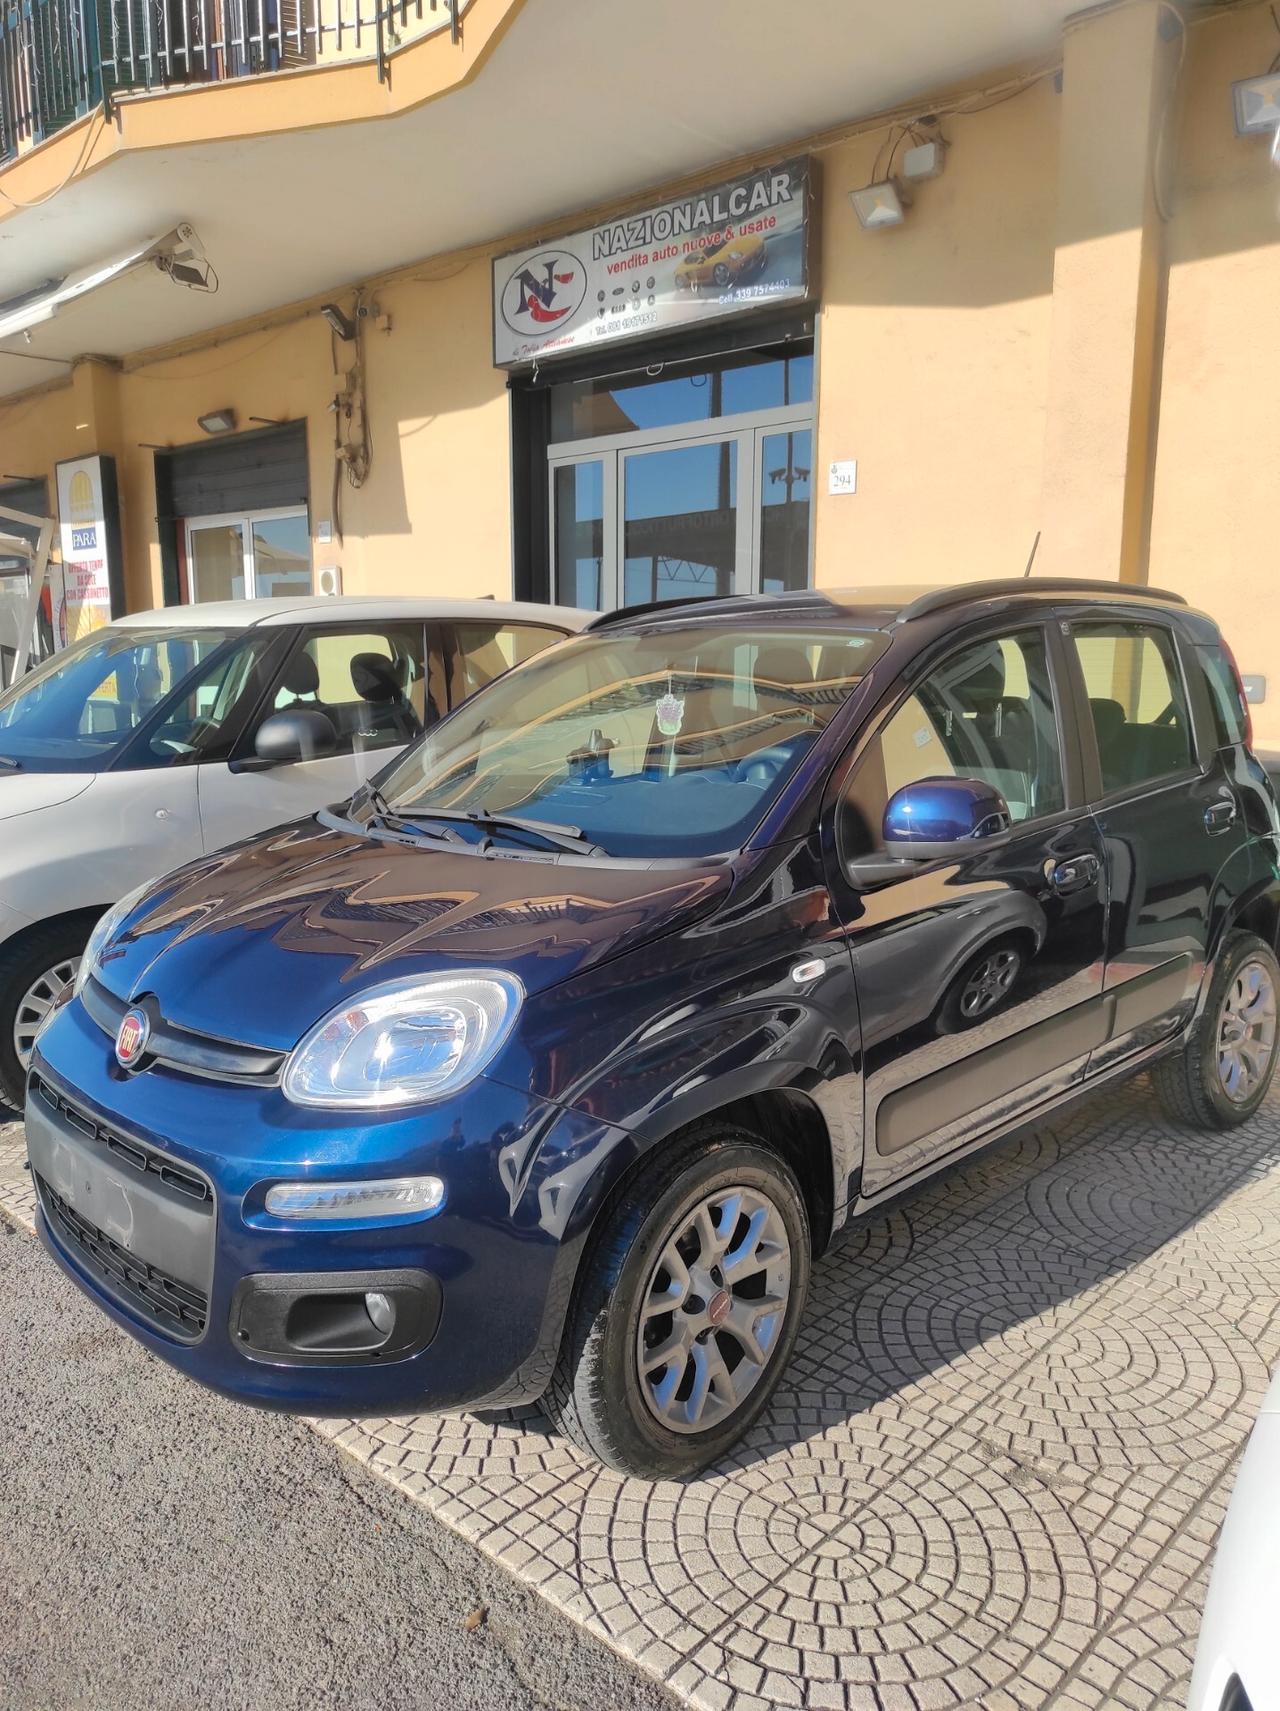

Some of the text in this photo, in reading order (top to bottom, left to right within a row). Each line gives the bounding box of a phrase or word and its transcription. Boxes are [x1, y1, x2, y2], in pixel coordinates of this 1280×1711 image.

[592, 172, 794, 261] NAZIONALCAR
[606, 215, 776, 275] vendita auto nuove & usate
[833, 474, 851, 488] 294
[73, 532, 97, 548] PARA
[119, 1025, 138, 1053] FIAT
